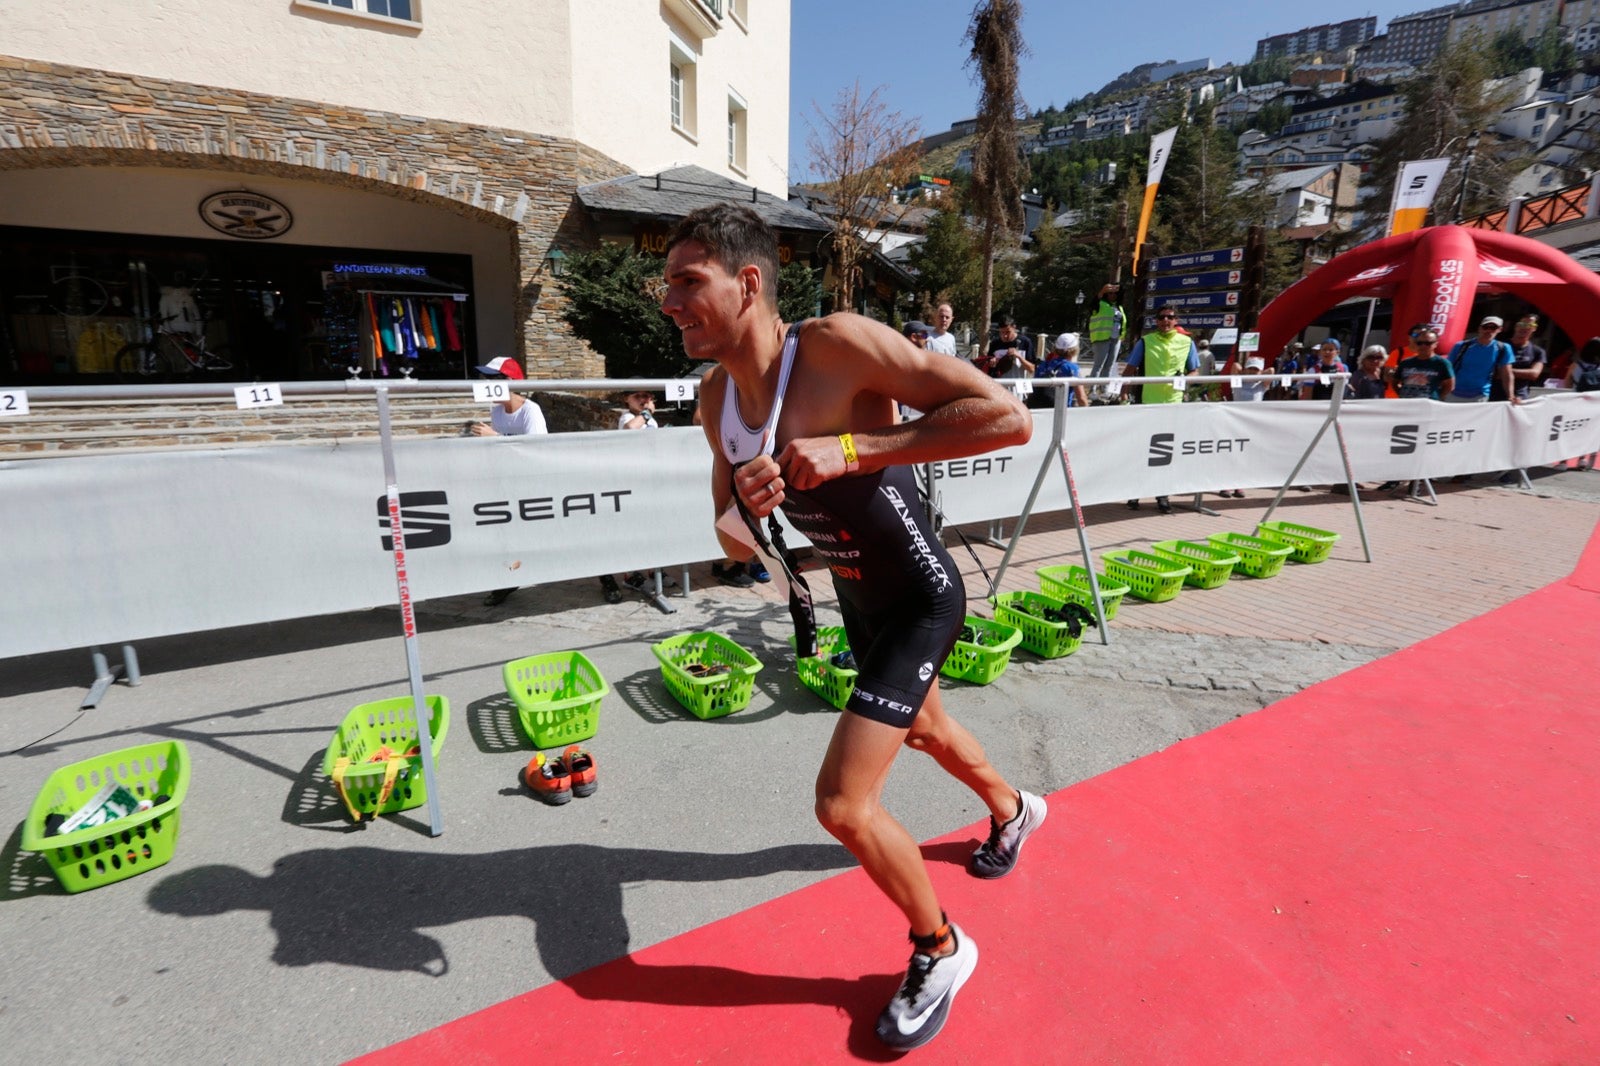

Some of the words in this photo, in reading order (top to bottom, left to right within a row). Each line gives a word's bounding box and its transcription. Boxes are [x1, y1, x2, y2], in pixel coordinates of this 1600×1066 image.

[250, 388, 274, 403] 11
[484, 384, 503, 398] 10
[677, 385, 686, 397] 9
[3, 395, 17, 410] 2
[1425, 429, 1475, 445] SEAT
[1181, 438, 1250, 456] SEAT
[933, 456, 1013, 480] SEAT
[473, 489, 632, 526] SEAT
[879, 486, 953, 588] SILVERBACK
[400, 585, 415, 639] GRANADA
[852, 687, 913, 715] ASTER
